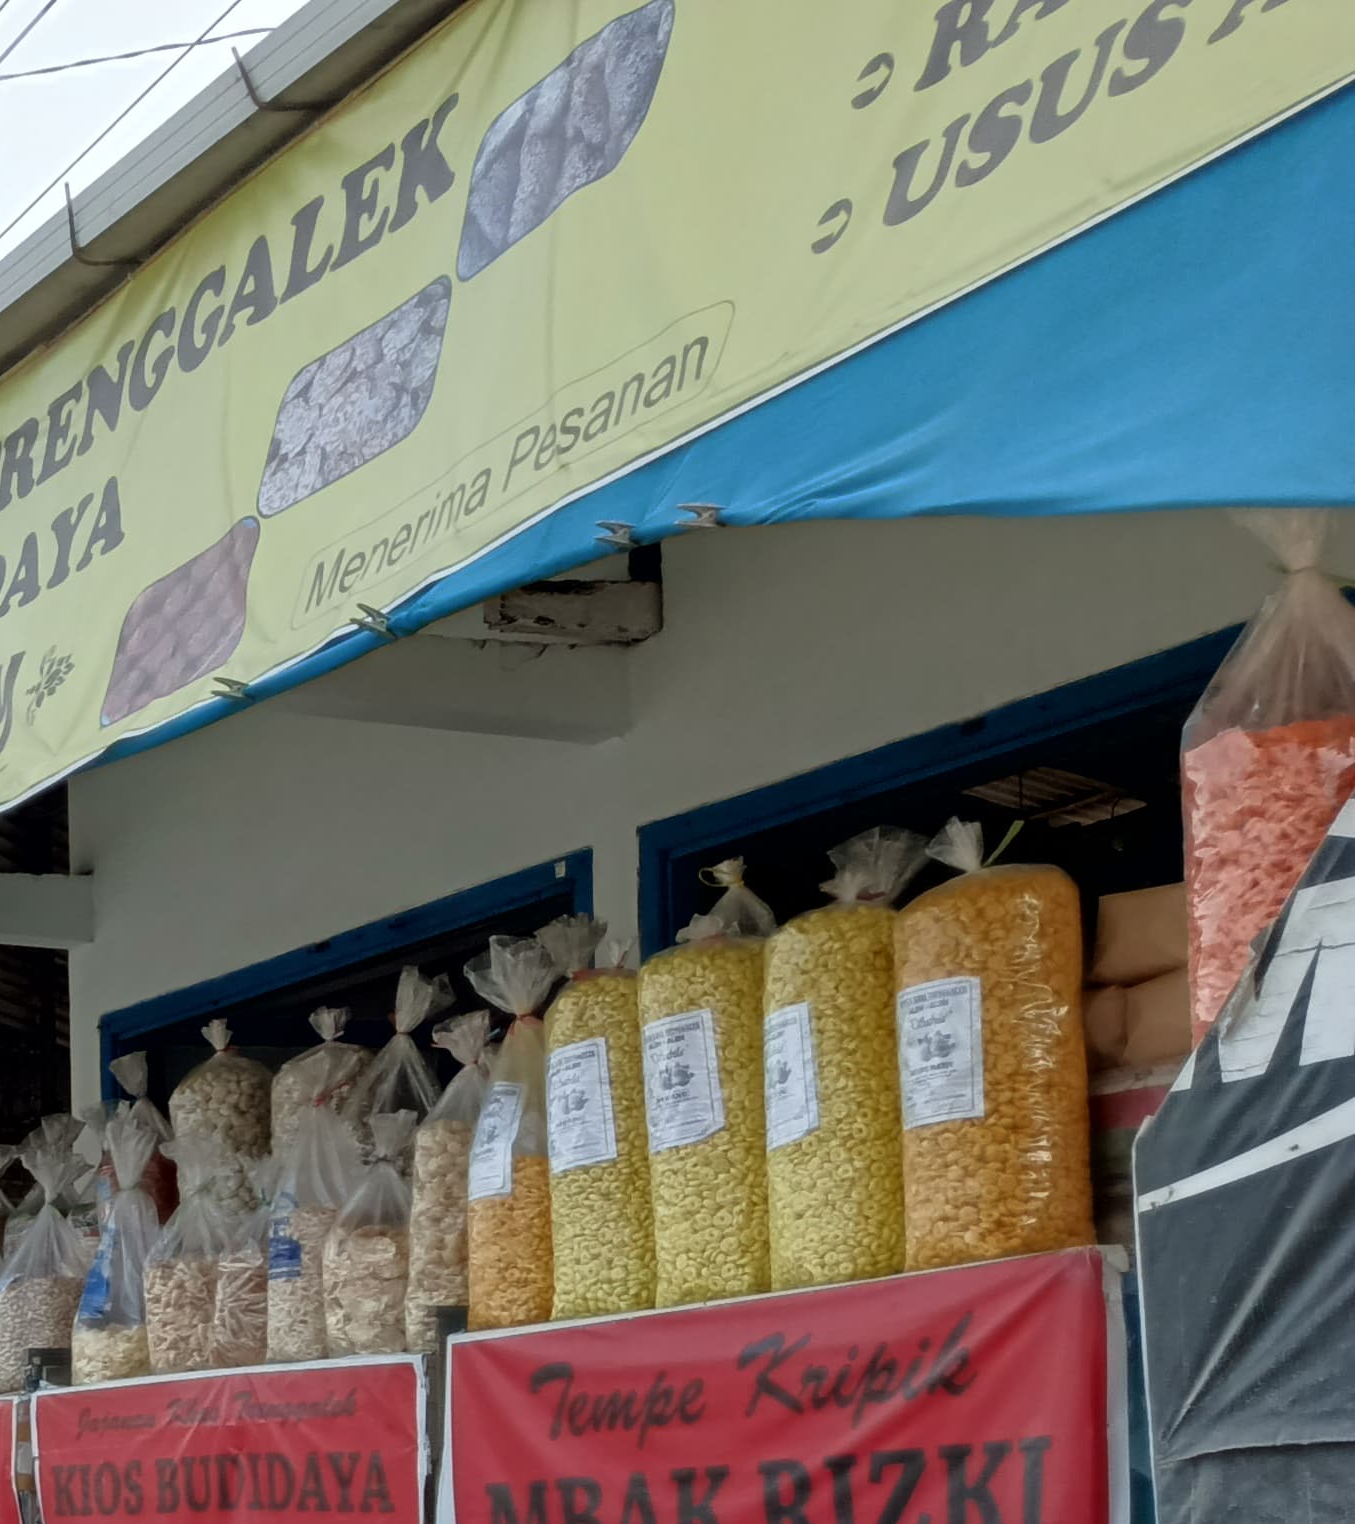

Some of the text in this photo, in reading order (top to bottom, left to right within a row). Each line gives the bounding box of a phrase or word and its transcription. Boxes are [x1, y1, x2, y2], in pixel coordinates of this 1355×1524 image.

[882, 0, 1187, 227] USUS
[304, 335, 710, 615] Menerima Pesanan
[529, 1311, 979, 1449] Tempe Kripik
[51, 1459, 145, 1517] KIOS
